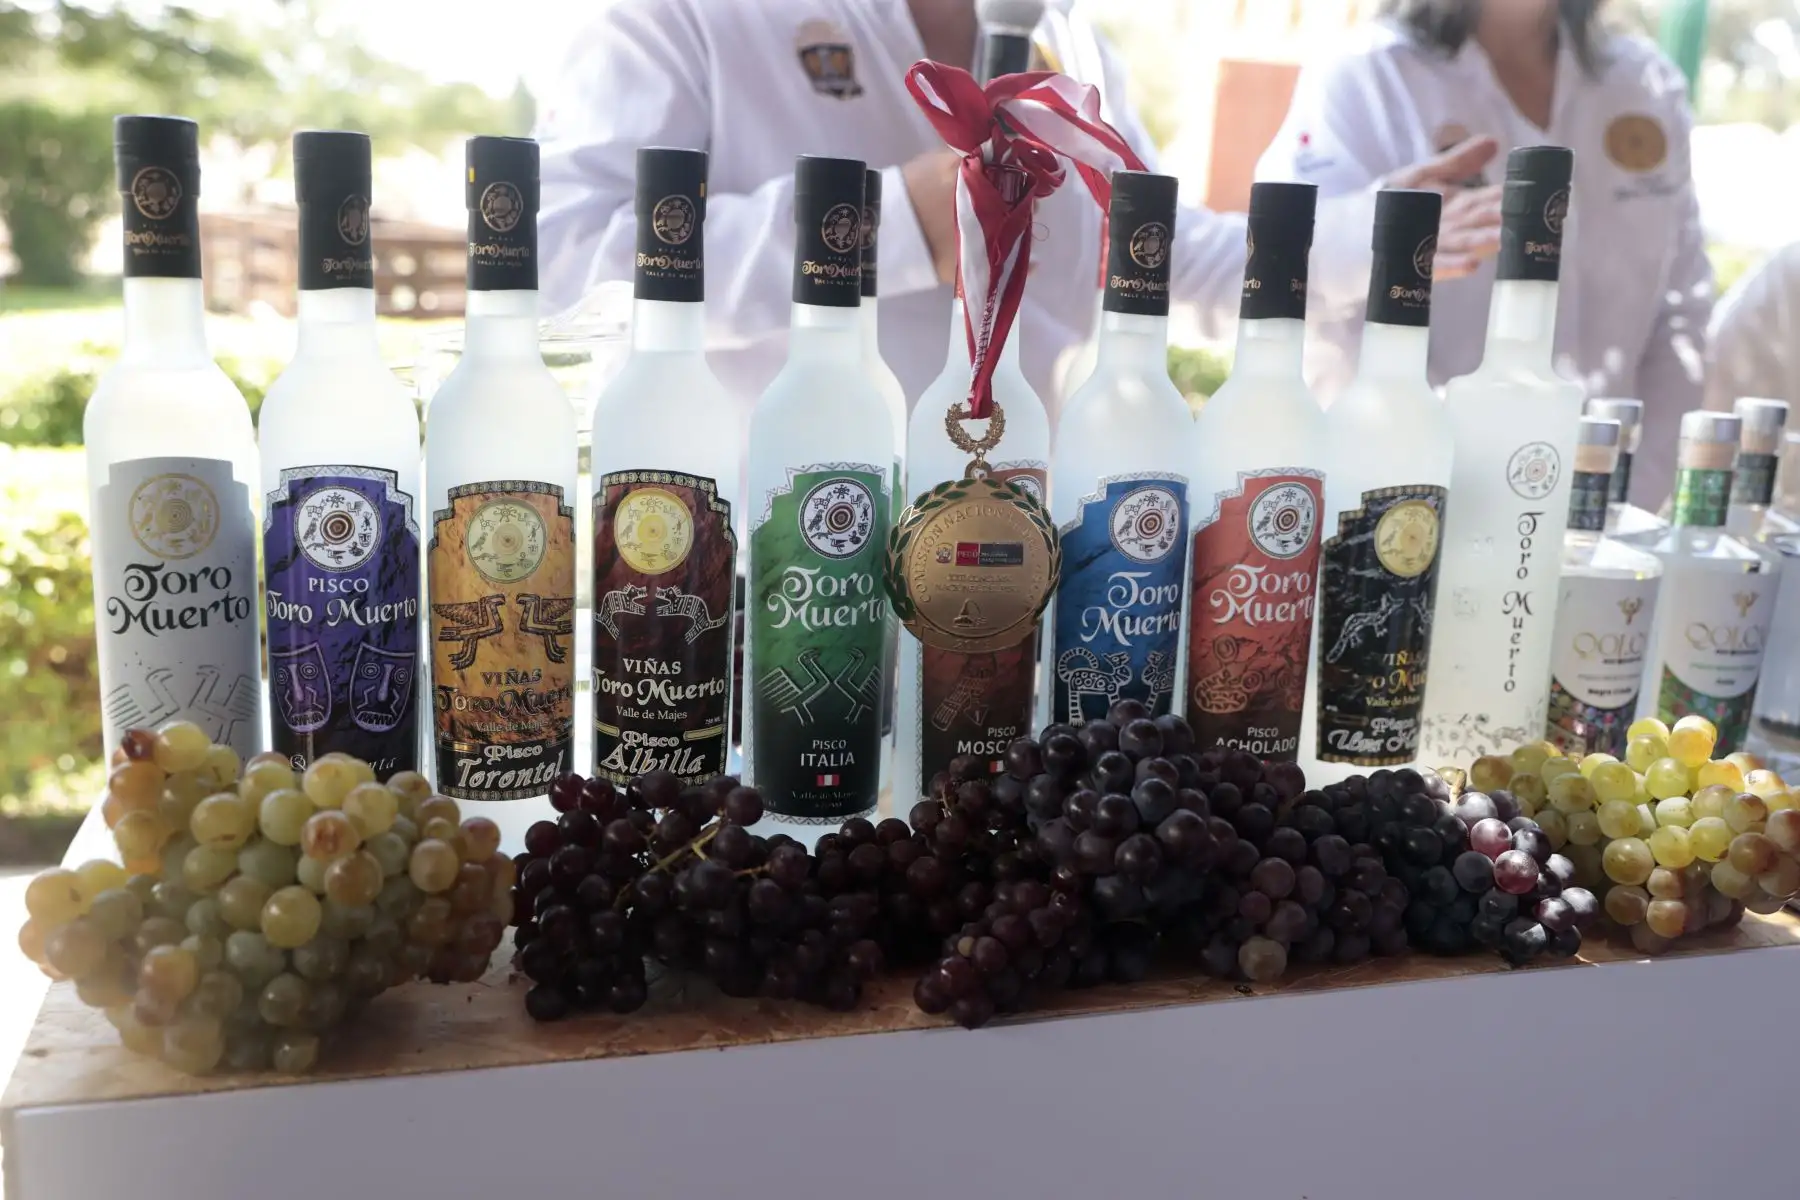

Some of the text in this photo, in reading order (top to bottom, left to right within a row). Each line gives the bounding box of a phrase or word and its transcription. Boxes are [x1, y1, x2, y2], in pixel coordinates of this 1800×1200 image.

[124, 562, 232, 601] Toro
[308, 578, 370, 593] PISCO
[782, 566, 875, 602] Toro
[1108, 571, 1179, 608] Toro
[1228, 564, 1311, 598] Toro
[266, 589, 416, 626] Toro Muerto
[767, 594, 886, 632] Muerto
[1502, 512, 1546, 693] Toro Muerto
[107, 594, 250, 638] Muerto
[1080, 606, 1180, 646] Muerto
[623, 657, 681, 676] VIÑAS
[479, 668, 542, 687] VIÑAS
[591, 667, 725, 707] Toro Muerto
[616, 706, 688, 723] Valle de Majes
[475, 721, 502, 733] Valle
[505, 721, 518, 731] de
[987, 725, 1017, 738] PISCO
[1247, 727, 1279, 739] PISCO
[622, 730, 680, 750] Pisco
[812, 738, 848, 750] PISCO
[1216, 736, 1297, 755] ACHOLADO
[483, 744, 543, 765] Pisco
[600, 743, 706, 776] Albilla
[800, 751, 856, 767] ITALIA
